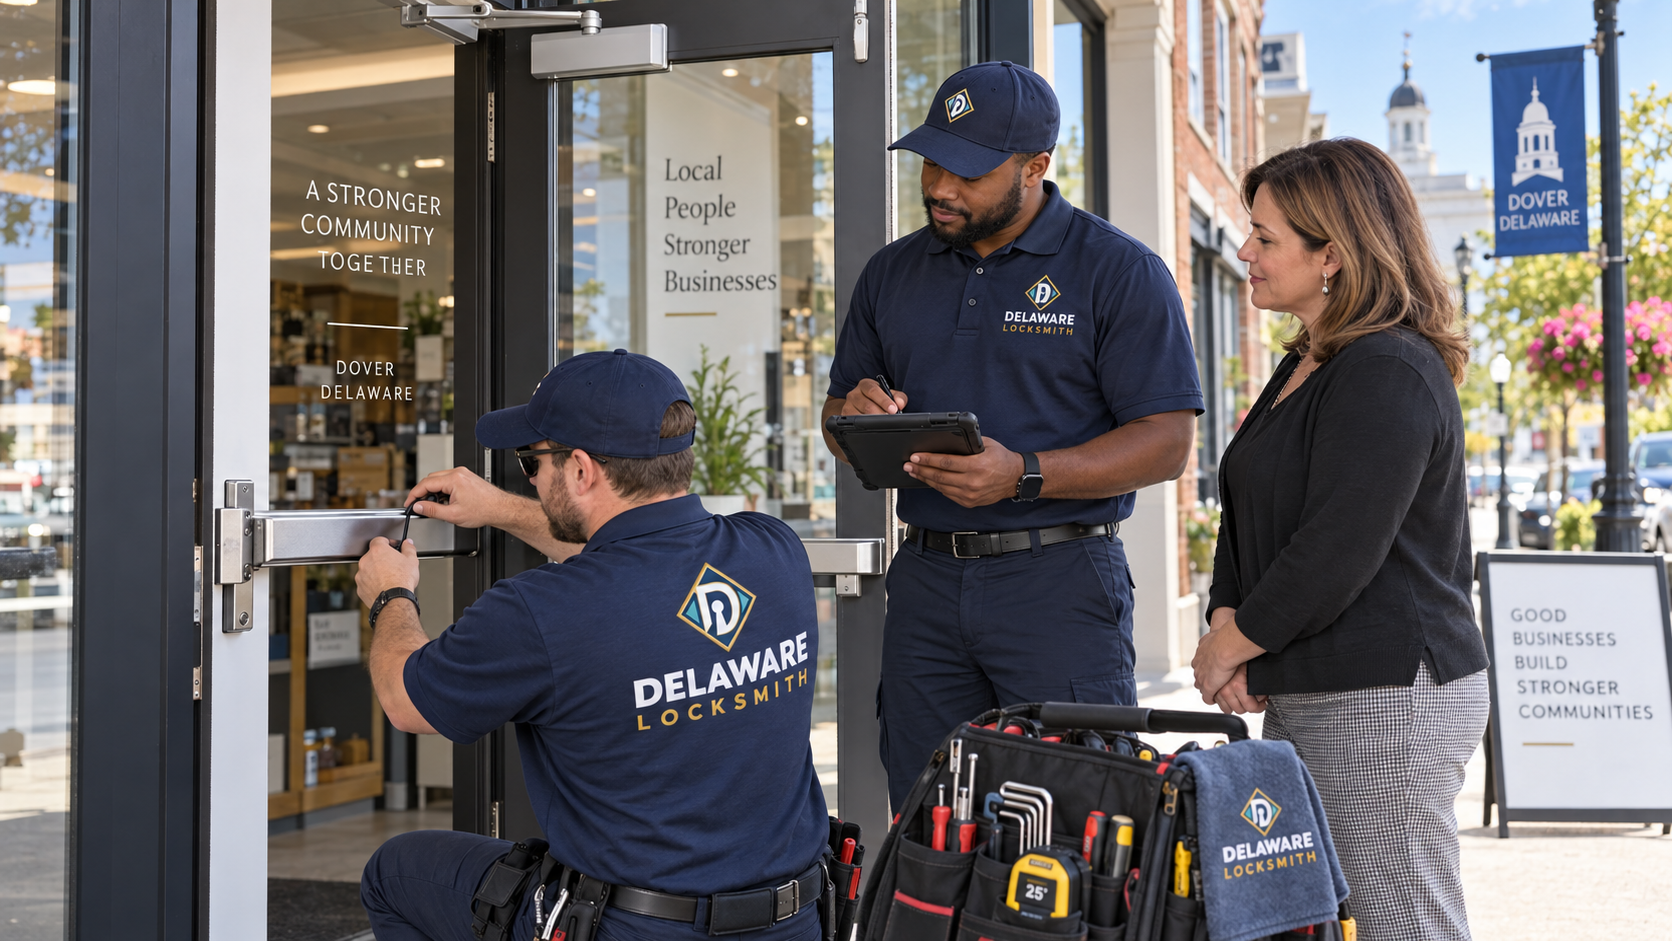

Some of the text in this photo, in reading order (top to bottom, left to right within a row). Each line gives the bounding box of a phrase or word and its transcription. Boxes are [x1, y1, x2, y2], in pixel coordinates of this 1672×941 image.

[665, 155, 722, 182] Local
[306, 180, 441, 216] A STRONGER
[1508, 189, 1569, 211] DOVER
[665, 194, 736, 226] People
[1499, 209, 1580, 232] DELAWARE
[301, 213, 435, 246] COMMUNITY
[664, 233, 750, 263] Stronger
[664, 270, 777, 293] Businesses
[1002, 323, 1074, 336] LOCKSMITH
[1004, 311, 1075, 326] DELAWARE
[336, 360, 394, 377] DOVER
[320, 384, 413, 402] DELAWARE
[1510, 608, 1567, 623] GOOD
[1512, 631, 1617, 647] BUSINESSES
[633, 631, 808, 709] DELAWARE
[1514, 655, 1568, 670] BUILD
[1516, 679, 1620, 695] STRONGER
[636, 668, 808, 731] LOCKSMITH
[1518, 704, 1654, 720] COMMUNITIES
[1222, 831, 1314, 864] DELAWARE
[1223, 850, 1317, 880] LOCKSMITH
